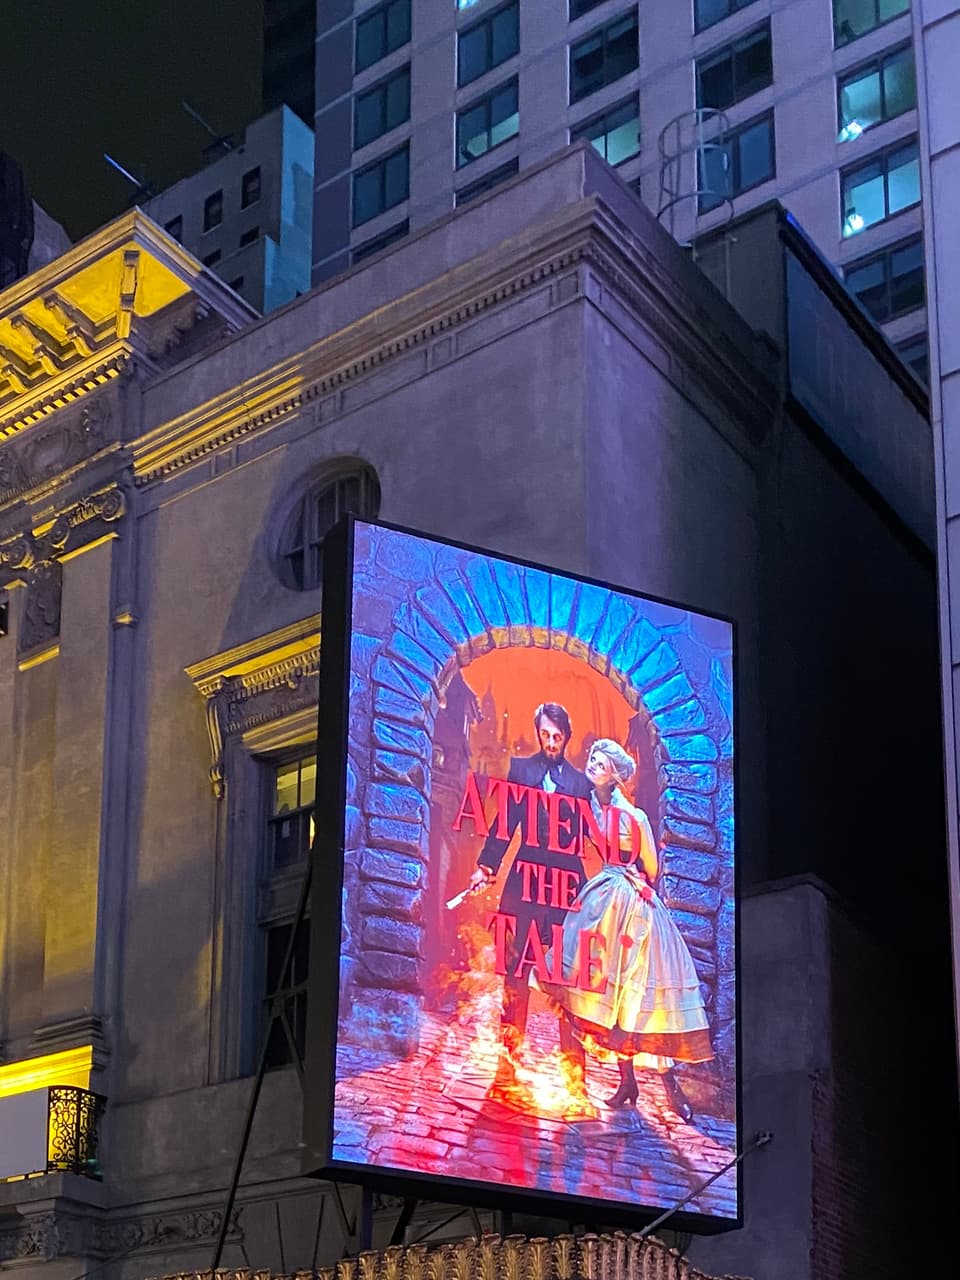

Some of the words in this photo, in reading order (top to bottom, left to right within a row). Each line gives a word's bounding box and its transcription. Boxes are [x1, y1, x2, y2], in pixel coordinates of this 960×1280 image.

[452, 770, 641, 867] ATTEND
[517, 860, 583, 913] THE
[486, 911, 608, 995] TALE
